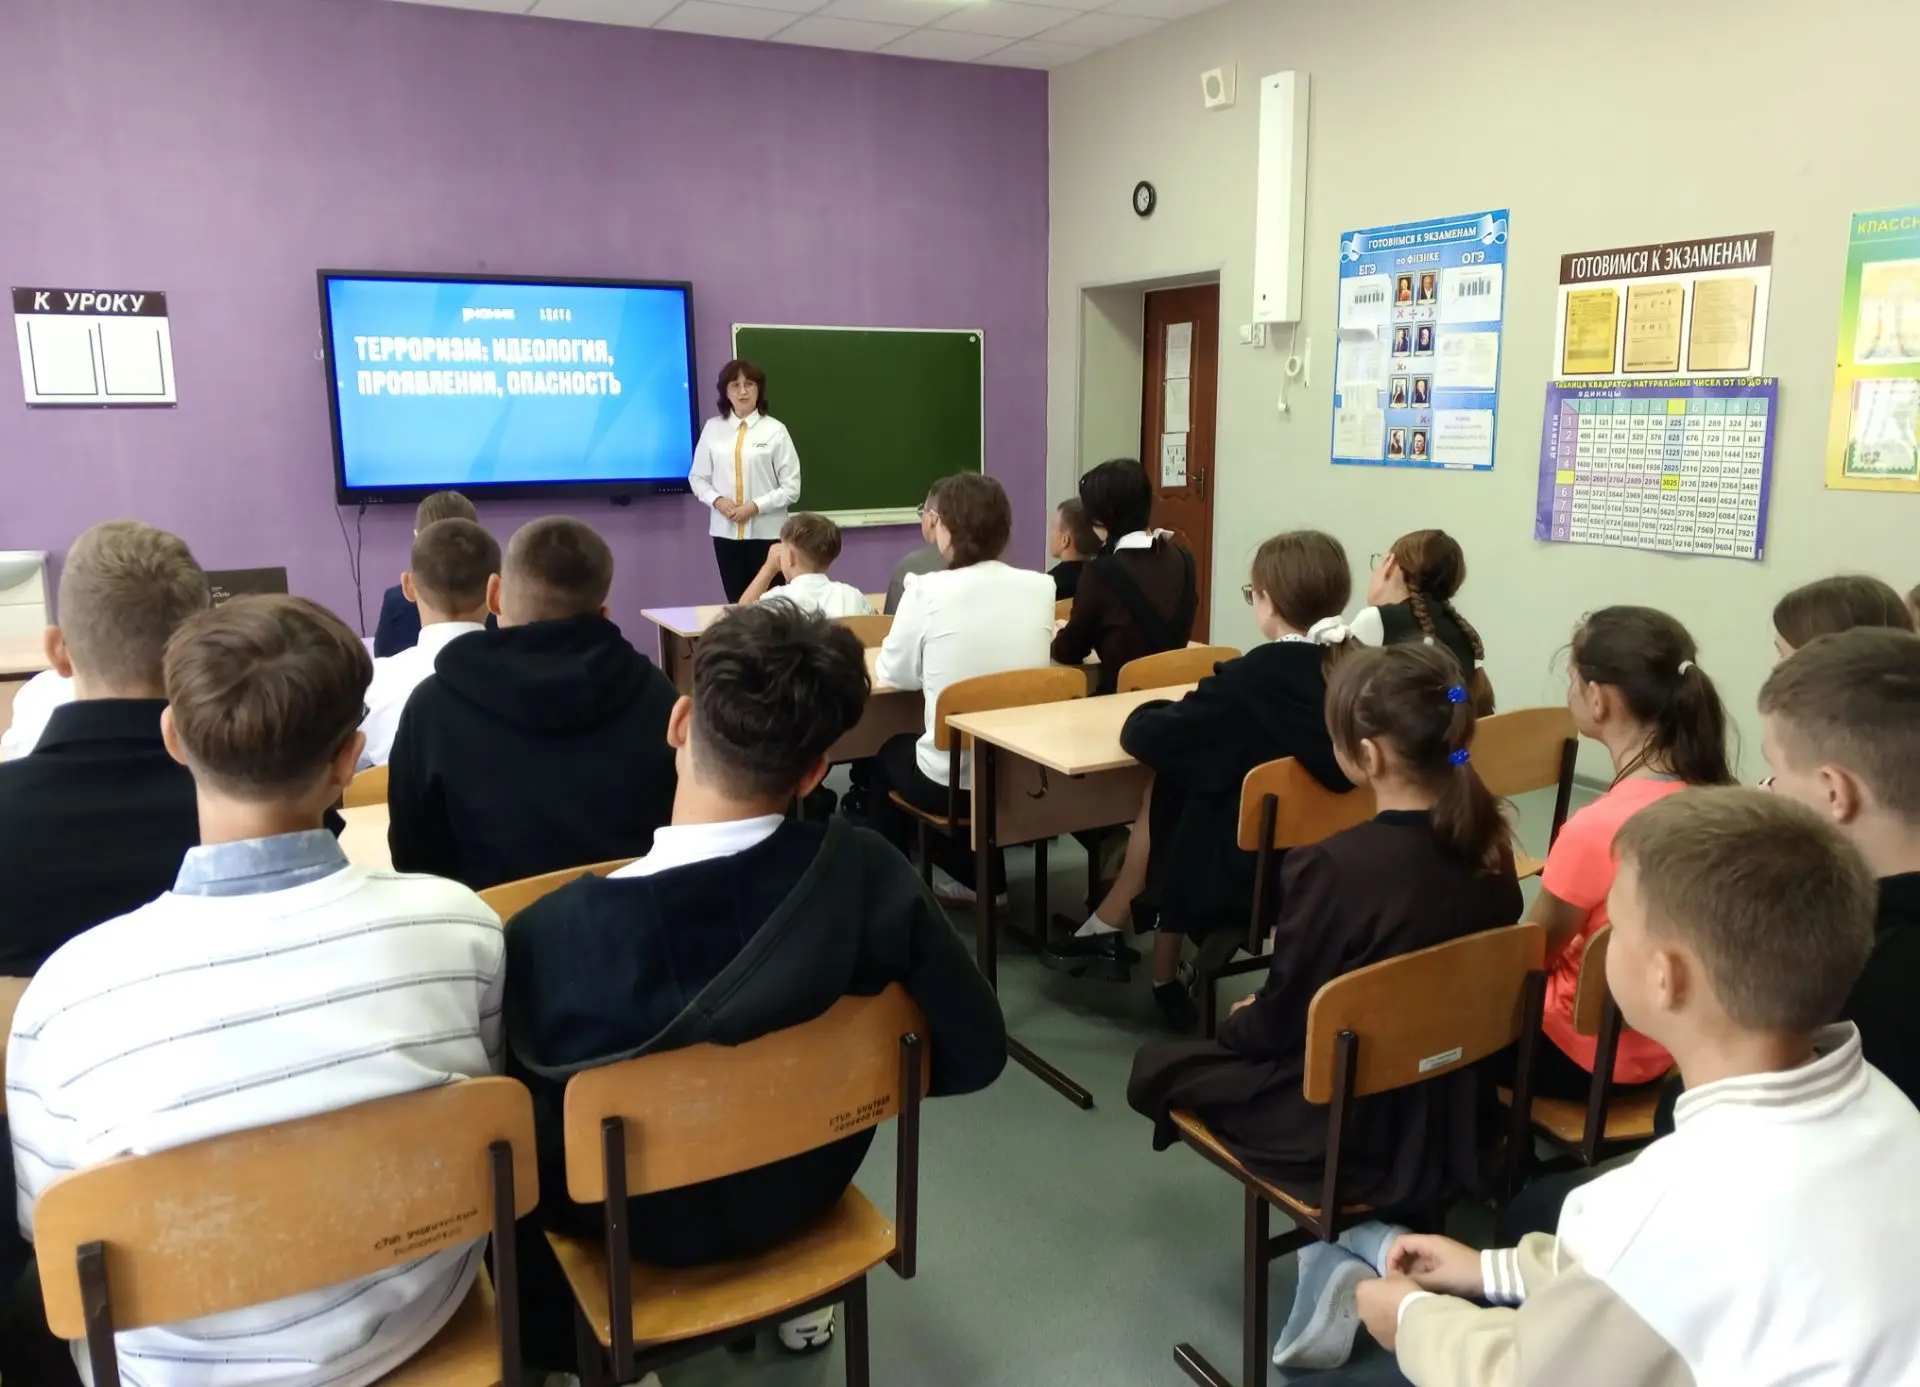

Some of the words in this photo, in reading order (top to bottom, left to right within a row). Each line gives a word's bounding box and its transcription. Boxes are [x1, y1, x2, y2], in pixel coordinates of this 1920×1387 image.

[1368, 235, 1415, 249] ГОТОВИМСЯ
[1416, 235, 1422, 243] К
[1423, 226, 1477, 242] ЭКЗАМЕНАМ
[1407, 251, 1440, 263] ФИЗИКЕ
[1461, 251, 1485, 264] ОГЭ
[1571, 251, 1648, 279] ГОТОВИМСЯ
[1651, 252, 1660, 271] К
[1664, 239, 1758, 269] ЭКЗАМЕНАМ
[1358, 264, 1377, 276] ЕГЭ
[34, 291, 50, 310] К
[63, 292, 145, 313] УРОКУ
[354, 336, 488, 362] ТЕРРОРИЗМ:
[492, 337, 614, 367] ИДЕОЛОГИЯ,
[357, 370, 504, 398] ПРОЯВЛЕНИЯ,
[507, 371, 621, 396] ОПАСНОСТЬ
[1633, 379, 1691, 388] НАТУРАЛЬНЫХ
[1693, 378, 1721, 387] ЧИСЕЛ
[1723, 378, 1735, 386] ОТ
[1737, 378, 1746, 386] 10
[1747, 377, 1761, 387] ДО
[1763, 377, 1773, 386] 99
